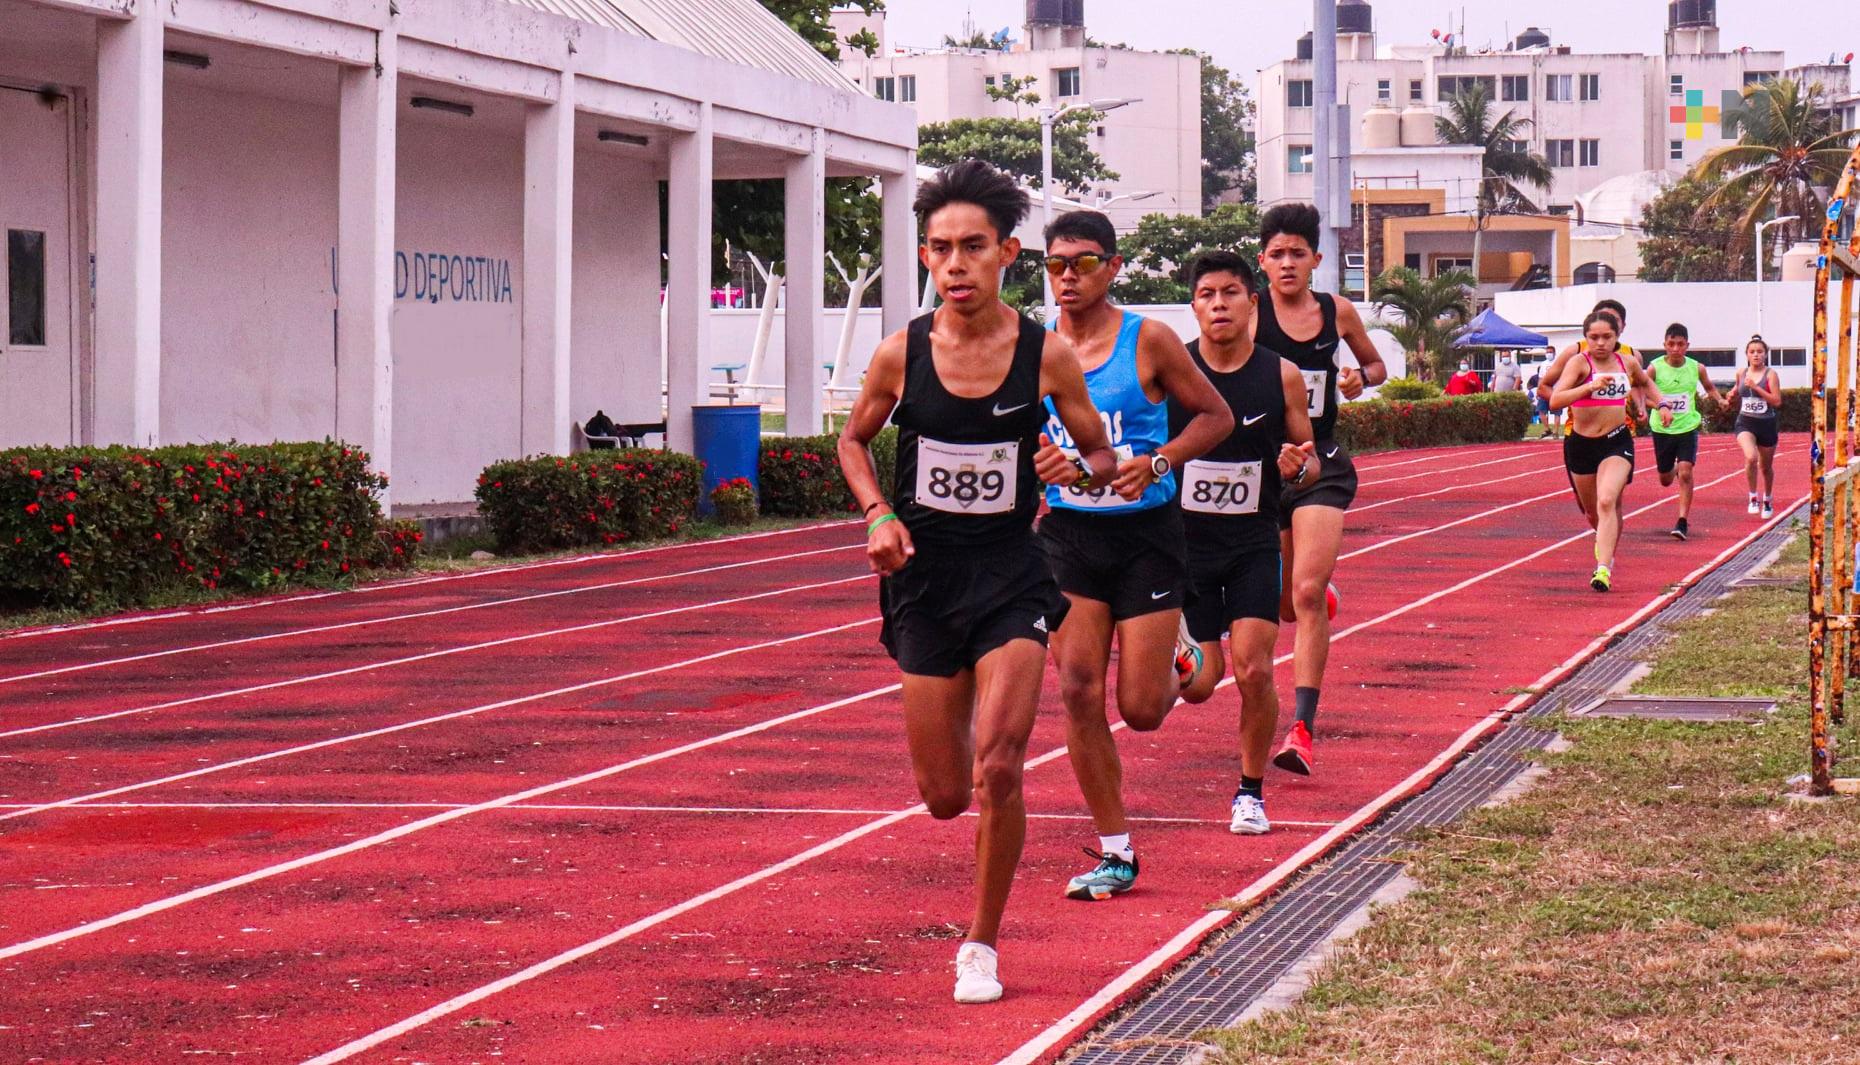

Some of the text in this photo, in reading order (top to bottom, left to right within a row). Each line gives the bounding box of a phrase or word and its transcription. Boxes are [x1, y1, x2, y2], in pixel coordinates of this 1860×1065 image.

[414, 252, 512, 303] DEPORTIVA
[1745, 402, 1764, 412] 865
[928, 466, 1004, 501] 889
[1192, 479, 1249, 505] 870
